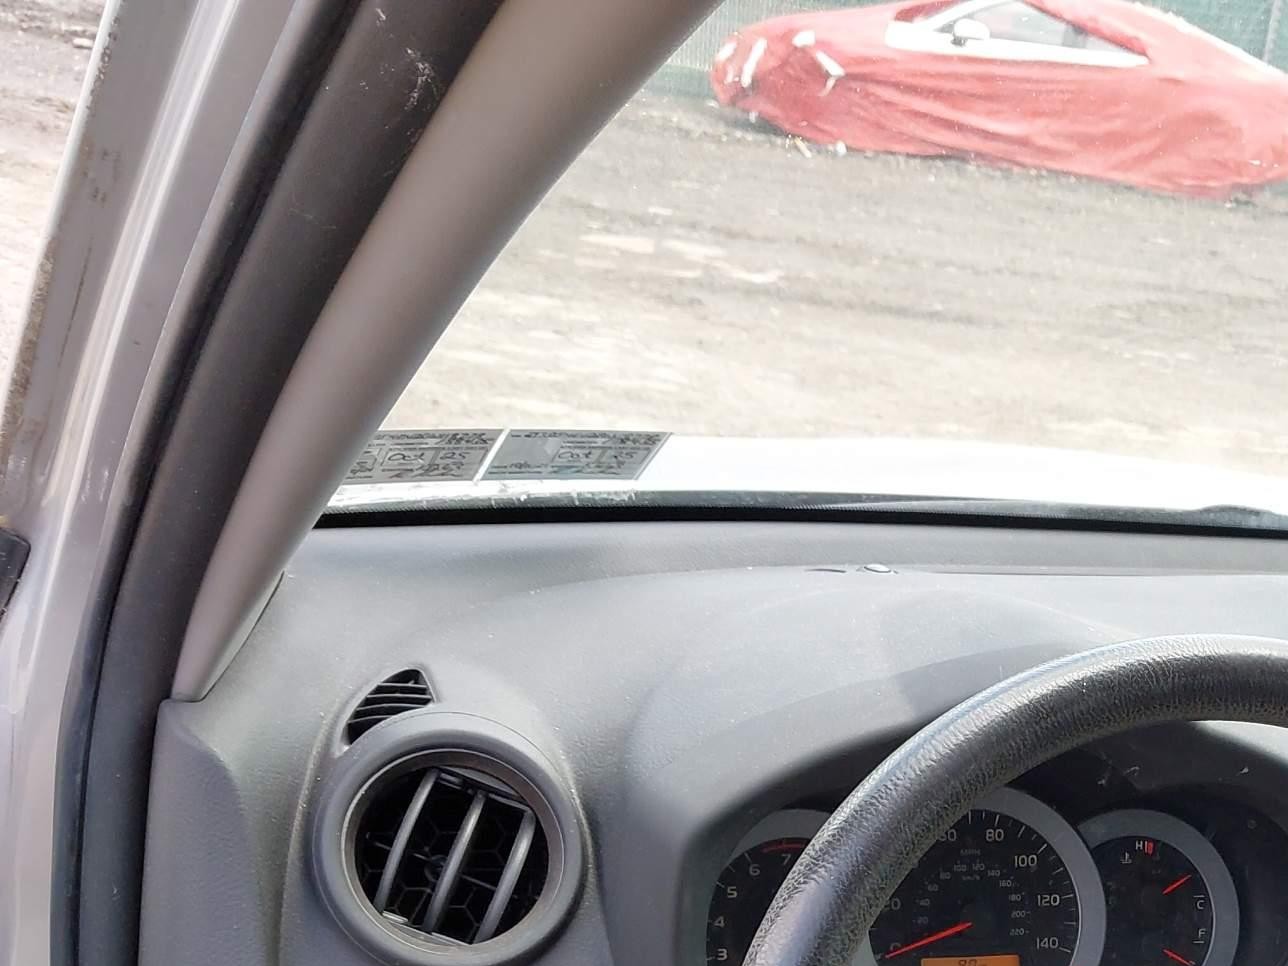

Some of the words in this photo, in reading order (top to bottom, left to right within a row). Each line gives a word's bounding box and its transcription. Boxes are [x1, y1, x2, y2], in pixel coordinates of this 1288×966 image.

[985, 828, 1004, 842] 80
[1135, 840, 1143, 850] H
[782, 853, 792, 866] 7
[1014, 855, 1037, 868] 100
[750, 863, 760, 876] 6
[727, 886, 738, 898] 5
[1037, 895, 1060, 907] 120
[1196, 900, 1205, 910] C
[714, 916, 725, 928] 4
[1198, 928, 1206, 938] F
[1036, 937, 1059, 949] 140
[716, 948, 727, 960] 3
